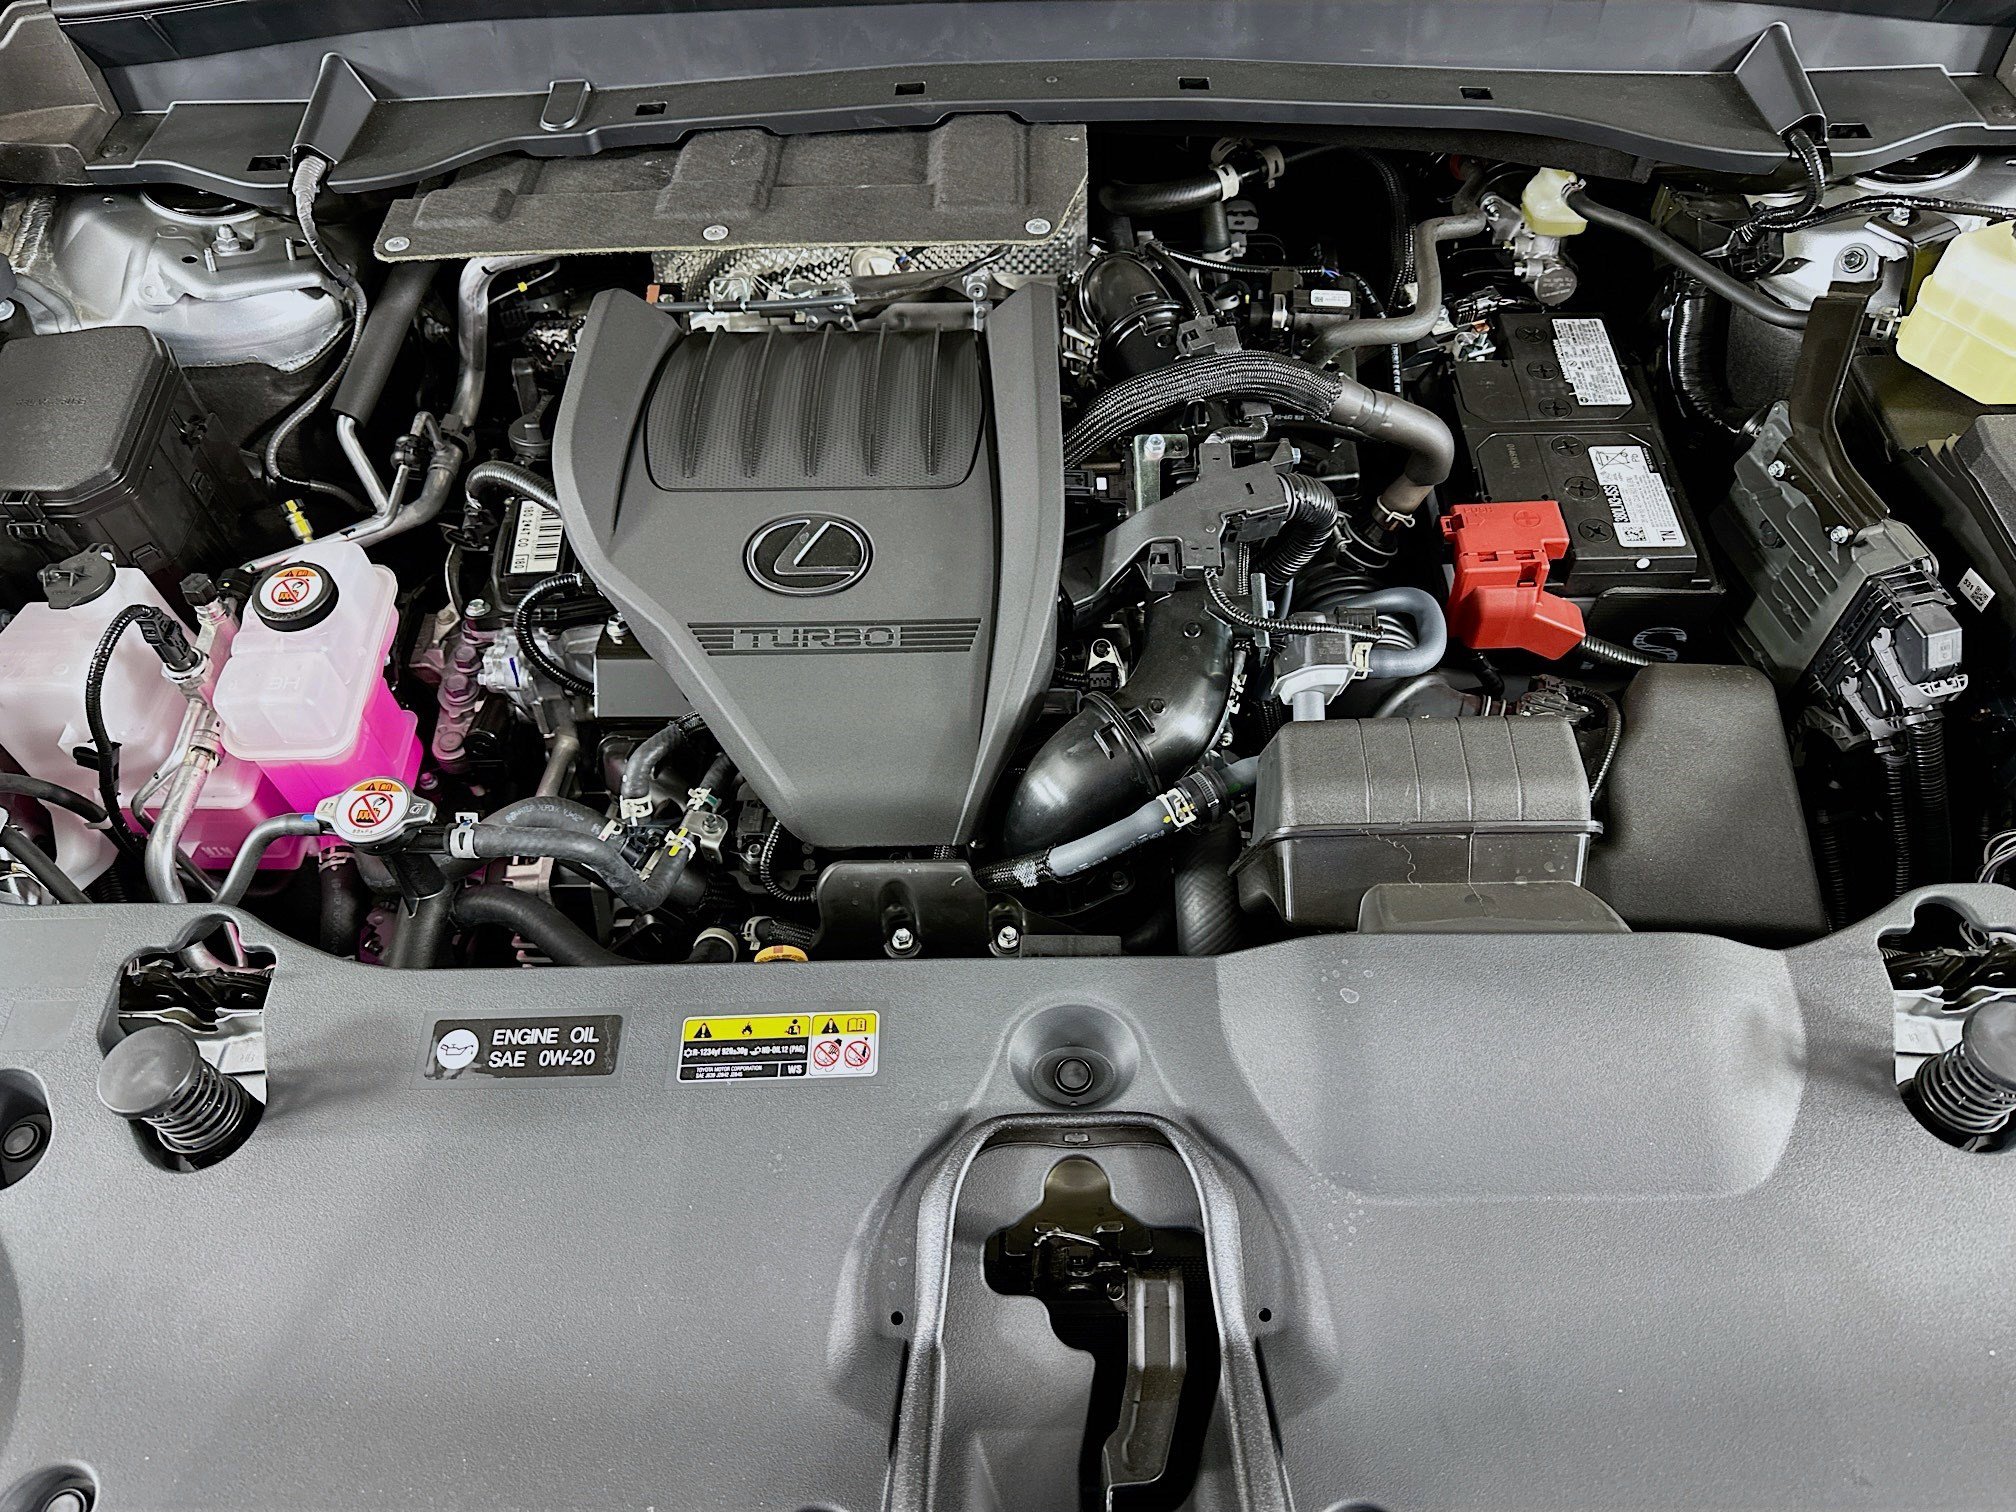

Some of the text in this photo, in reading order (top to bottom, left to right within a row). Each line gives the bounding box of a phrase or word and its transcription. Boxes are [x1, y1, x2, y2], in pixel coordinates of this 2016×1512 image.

[1962, 578, 1975, 591] 531
[740, 627, 896, 649] TURBO
[492, 1026, 600, 1046] ENGINE OIL
[488, 1048, 596, 1068] SAE 0W-20
[787, 1064, 803, 1075] WS
